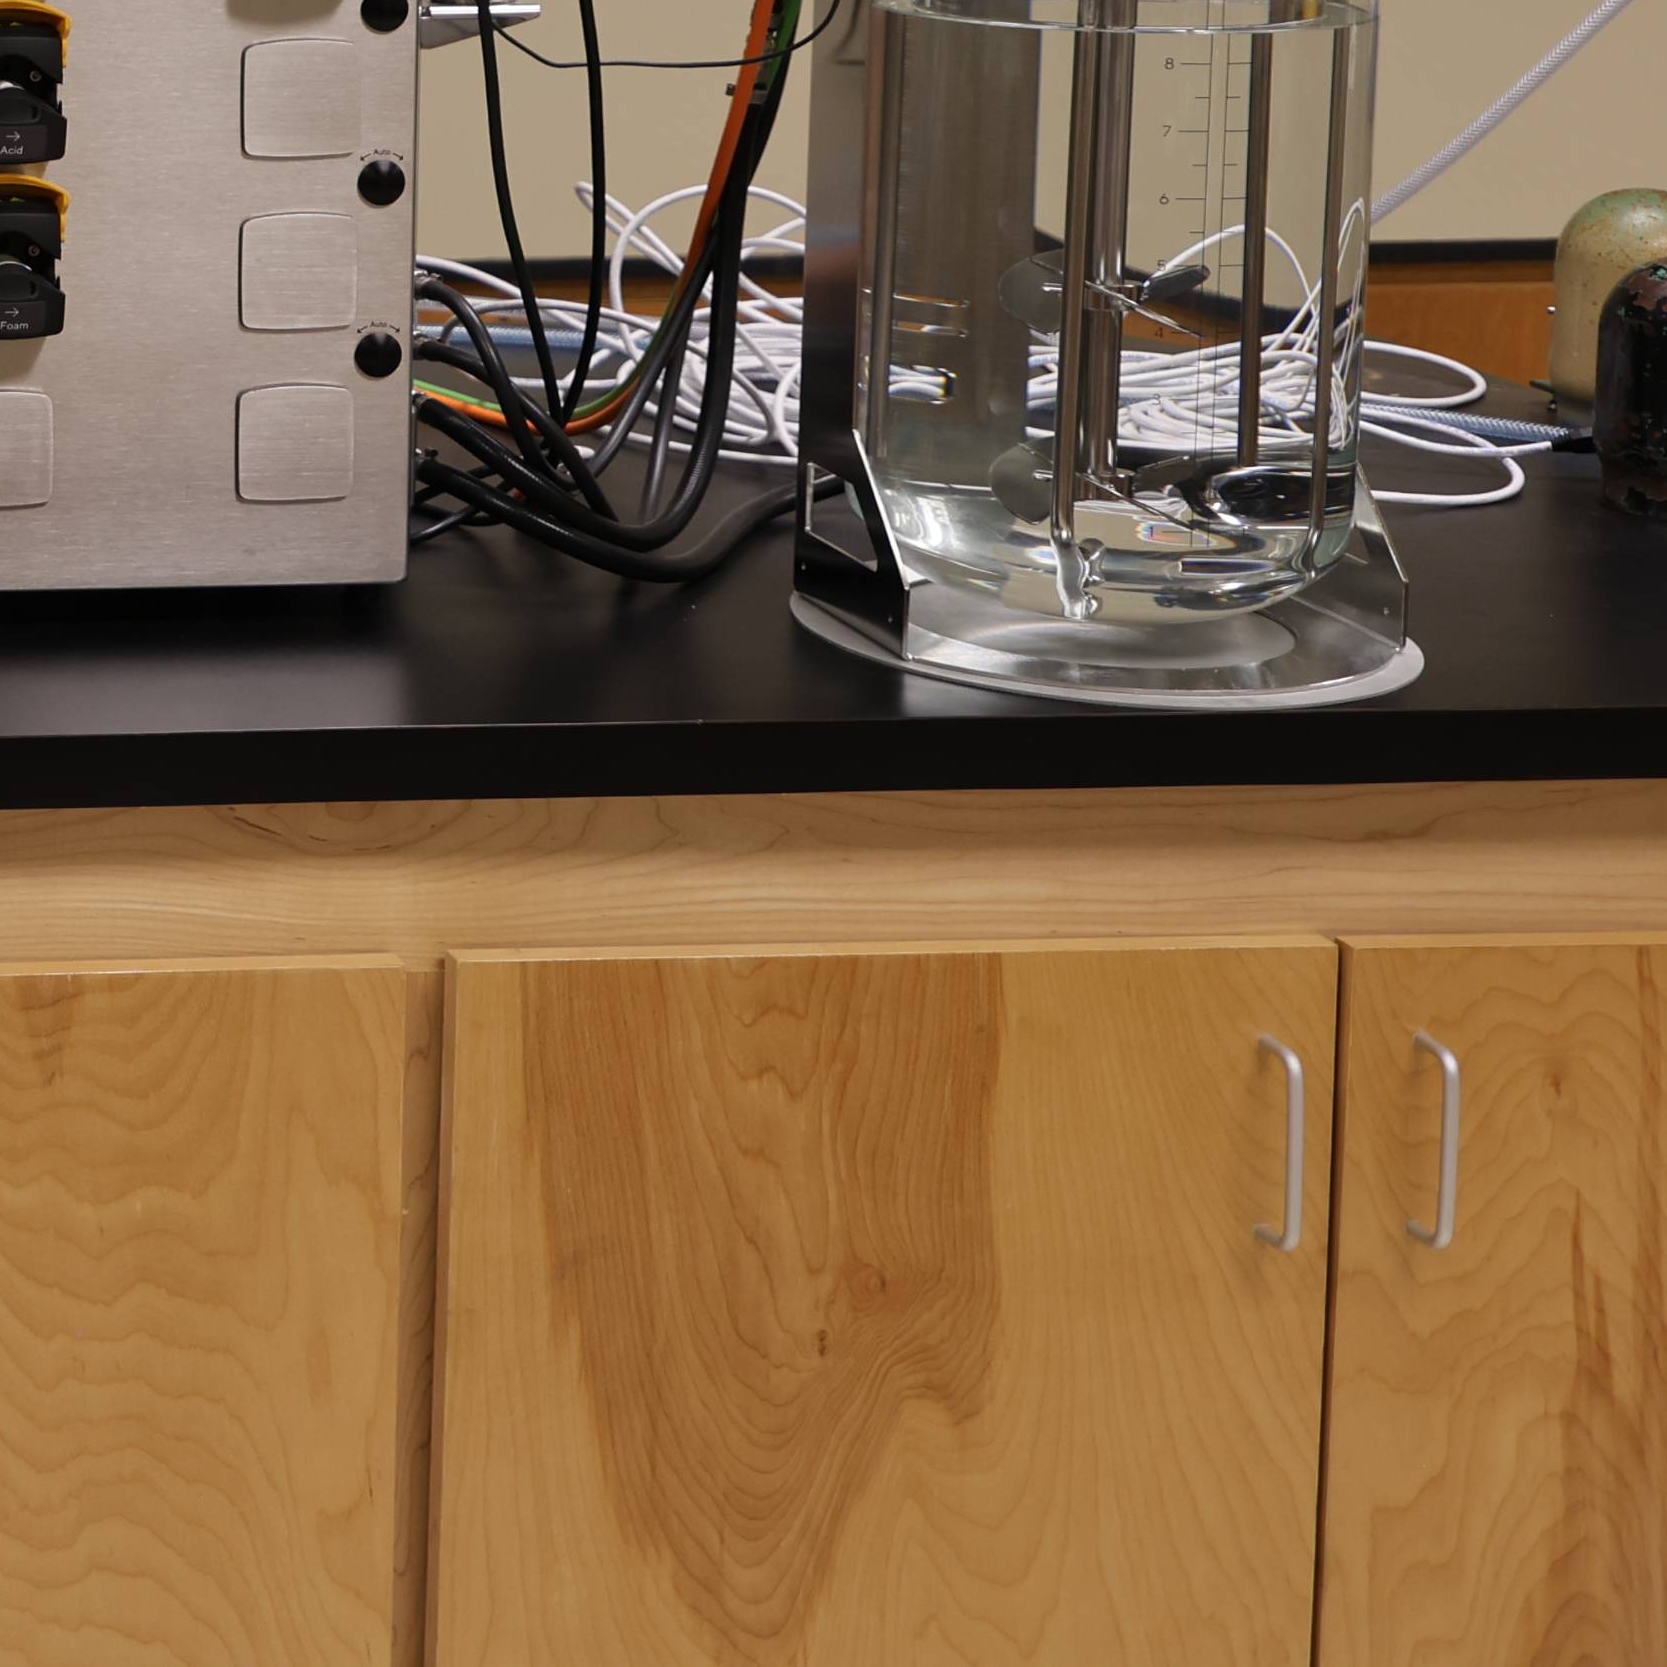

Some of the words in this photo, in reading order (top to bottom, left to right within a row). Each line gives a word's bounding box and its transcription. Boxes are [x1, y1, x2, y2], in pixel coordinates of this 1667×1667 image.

[1164, 59, 1174, 70] 8
[1163, 126, 1172, 136] 7
[0, 145, 24, 156] Acid
[374, 148, 391, 156] Auto
[1159, 194, 1170, 204] 6
[370, 321, 388, 329] Auto
